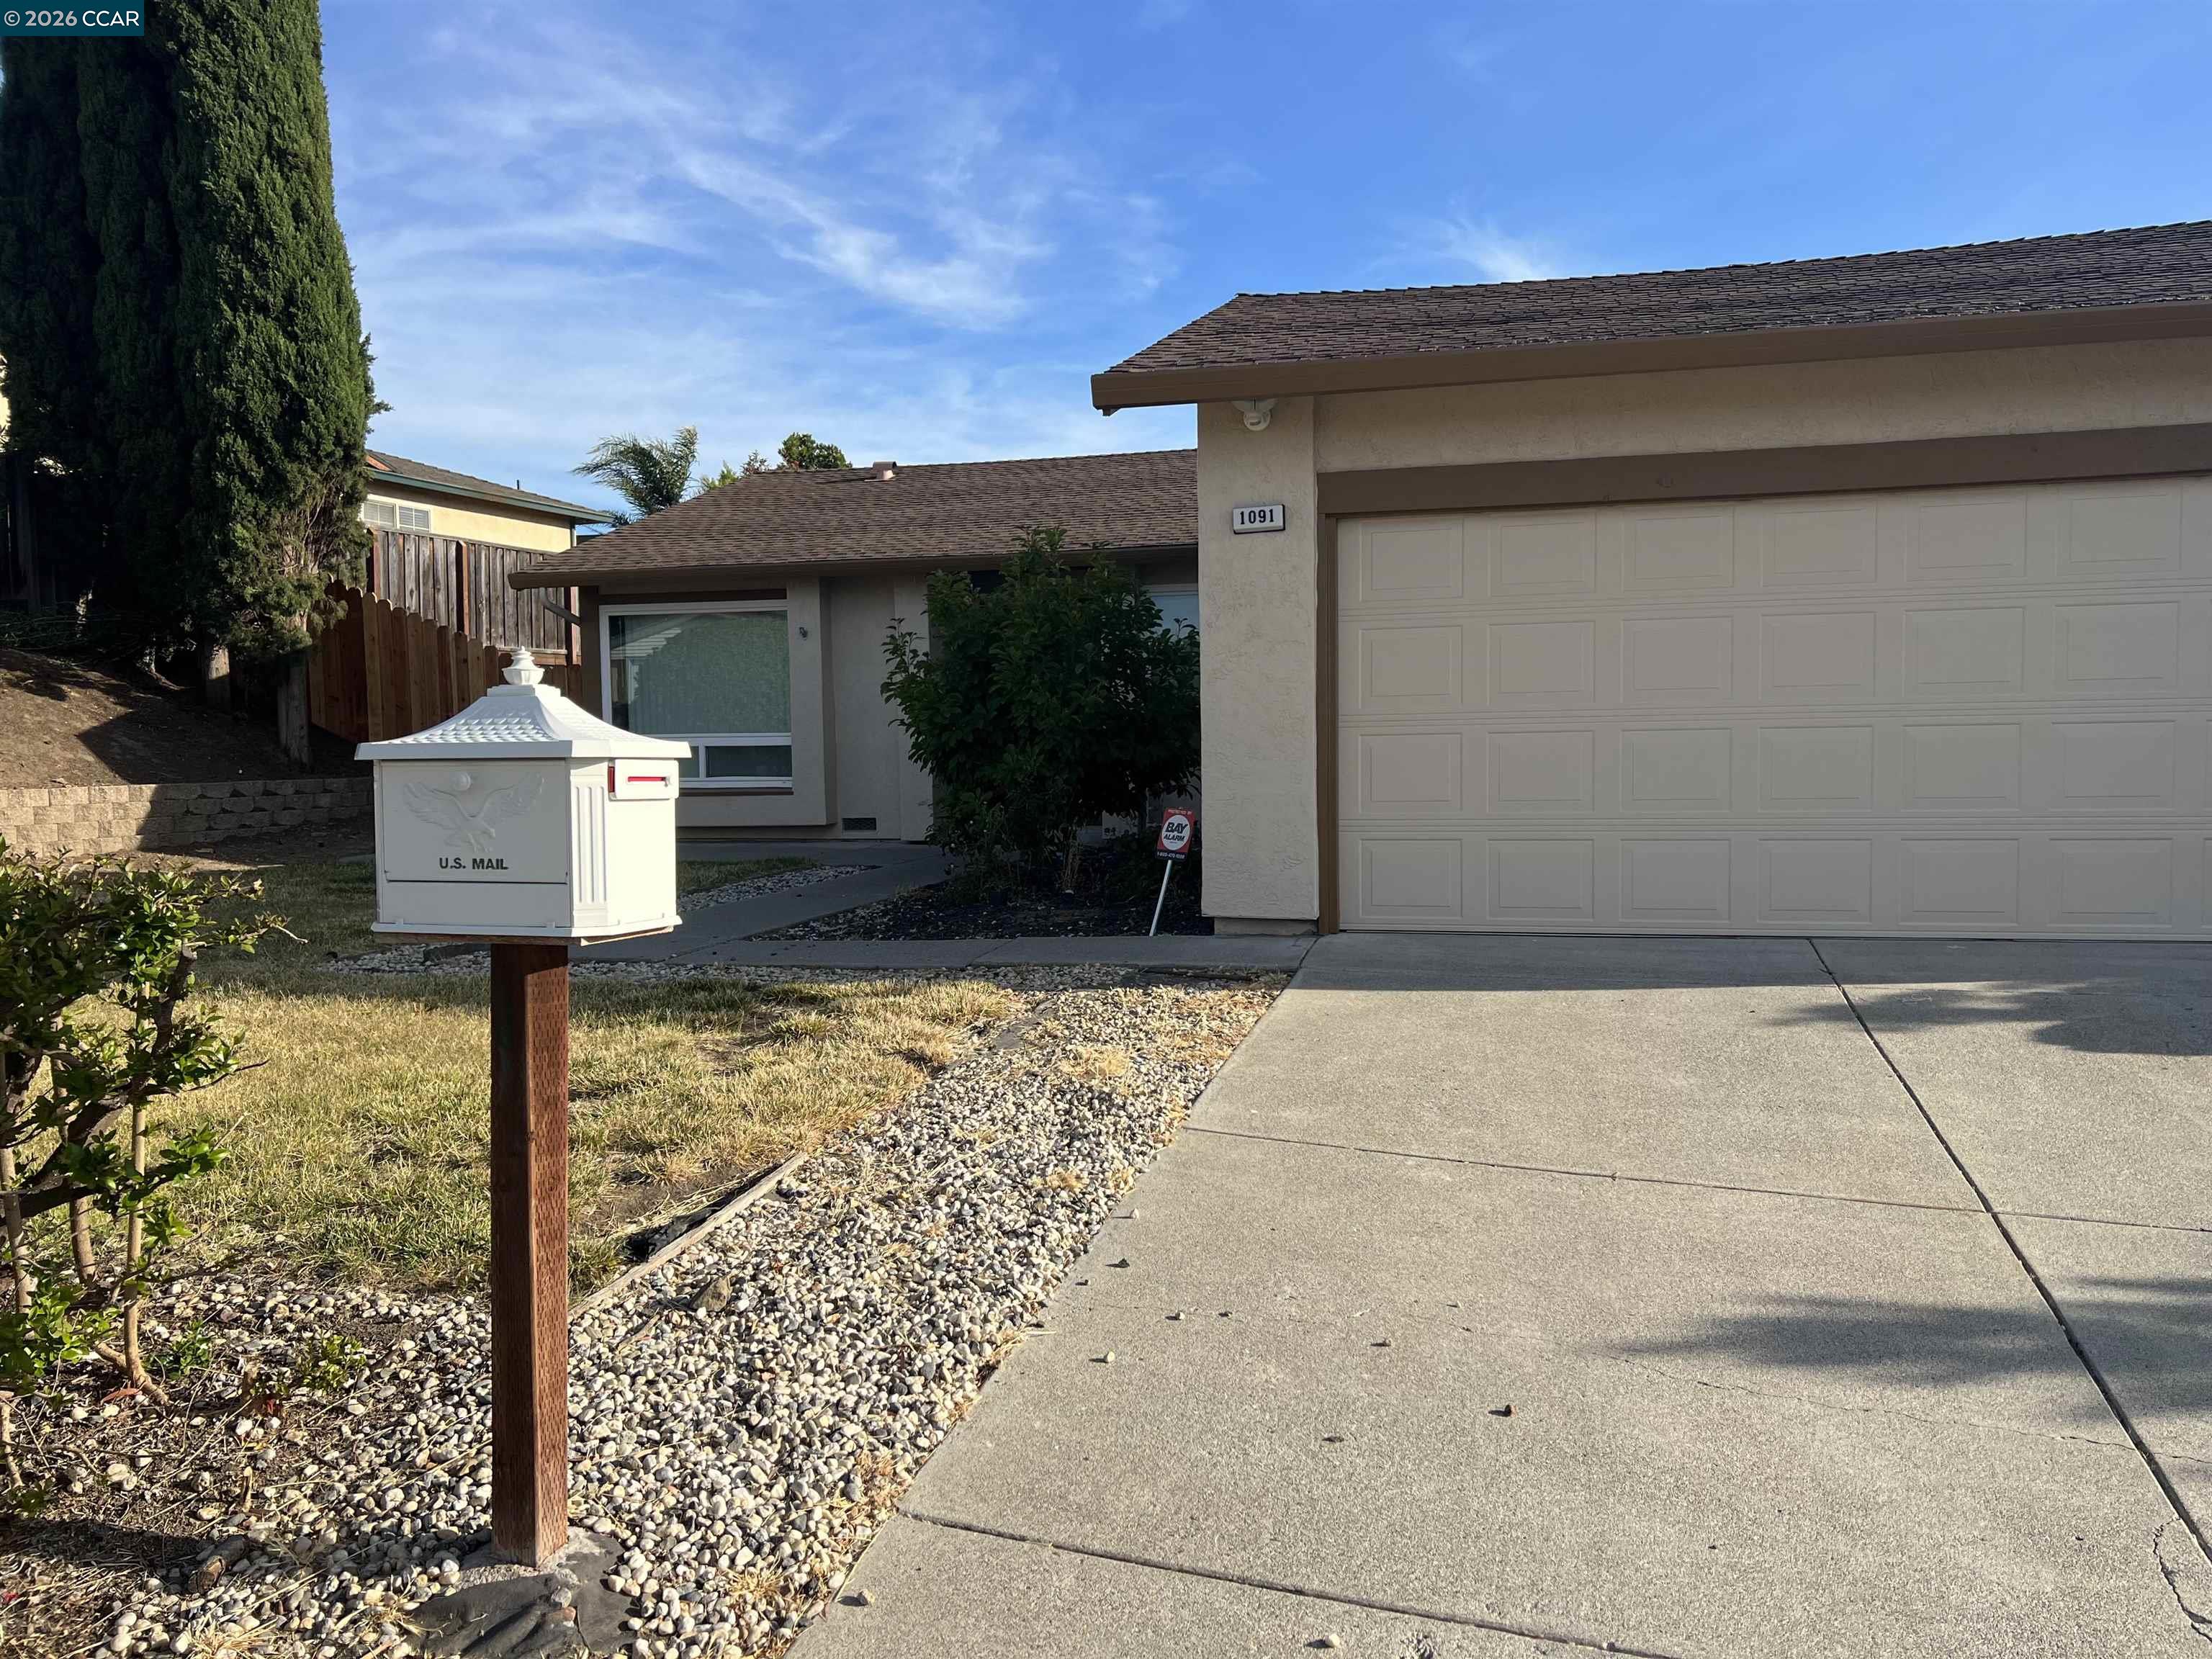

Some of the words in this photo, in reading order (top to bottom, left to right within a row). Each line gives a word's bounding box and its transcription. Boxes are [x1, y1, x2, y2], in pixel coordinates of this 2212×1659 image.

[1239, 508, 1274, 525] 1091
[1165, 822, 1189, 834] BAY
[439, 857, 467, 869] U.S.
[472, 858, 509, 870] MAIL
